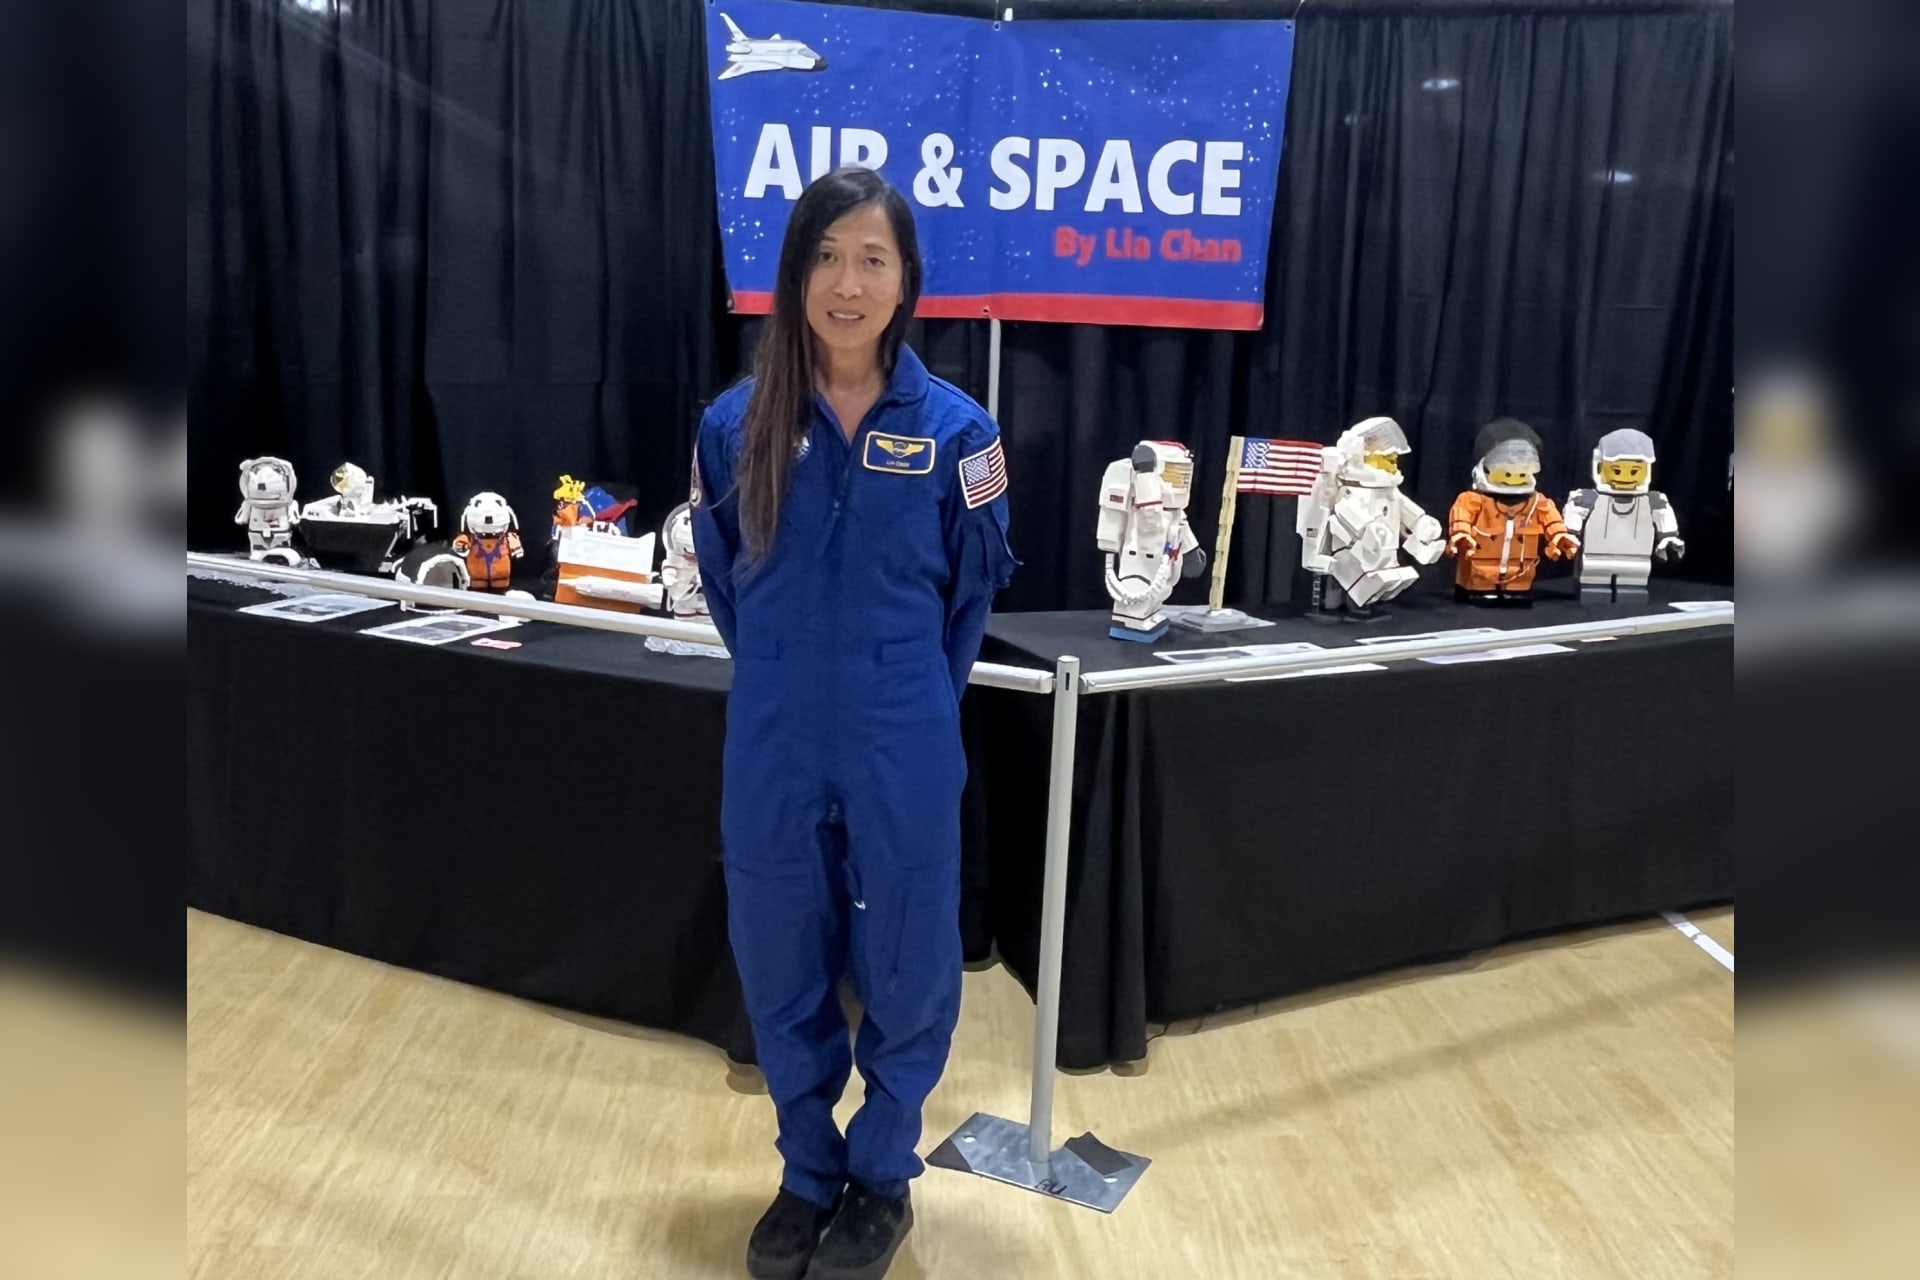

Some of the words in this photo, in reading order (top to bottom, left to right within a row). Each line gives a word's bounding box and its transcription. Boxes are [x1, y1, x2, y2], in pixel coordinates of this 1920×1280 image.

[913, 132, 965, 208] &
[990, 136, 1243, 216] SPACE
[1055, 226, 1096, 266] By
[1160, 228, 1242, 263] Chan
